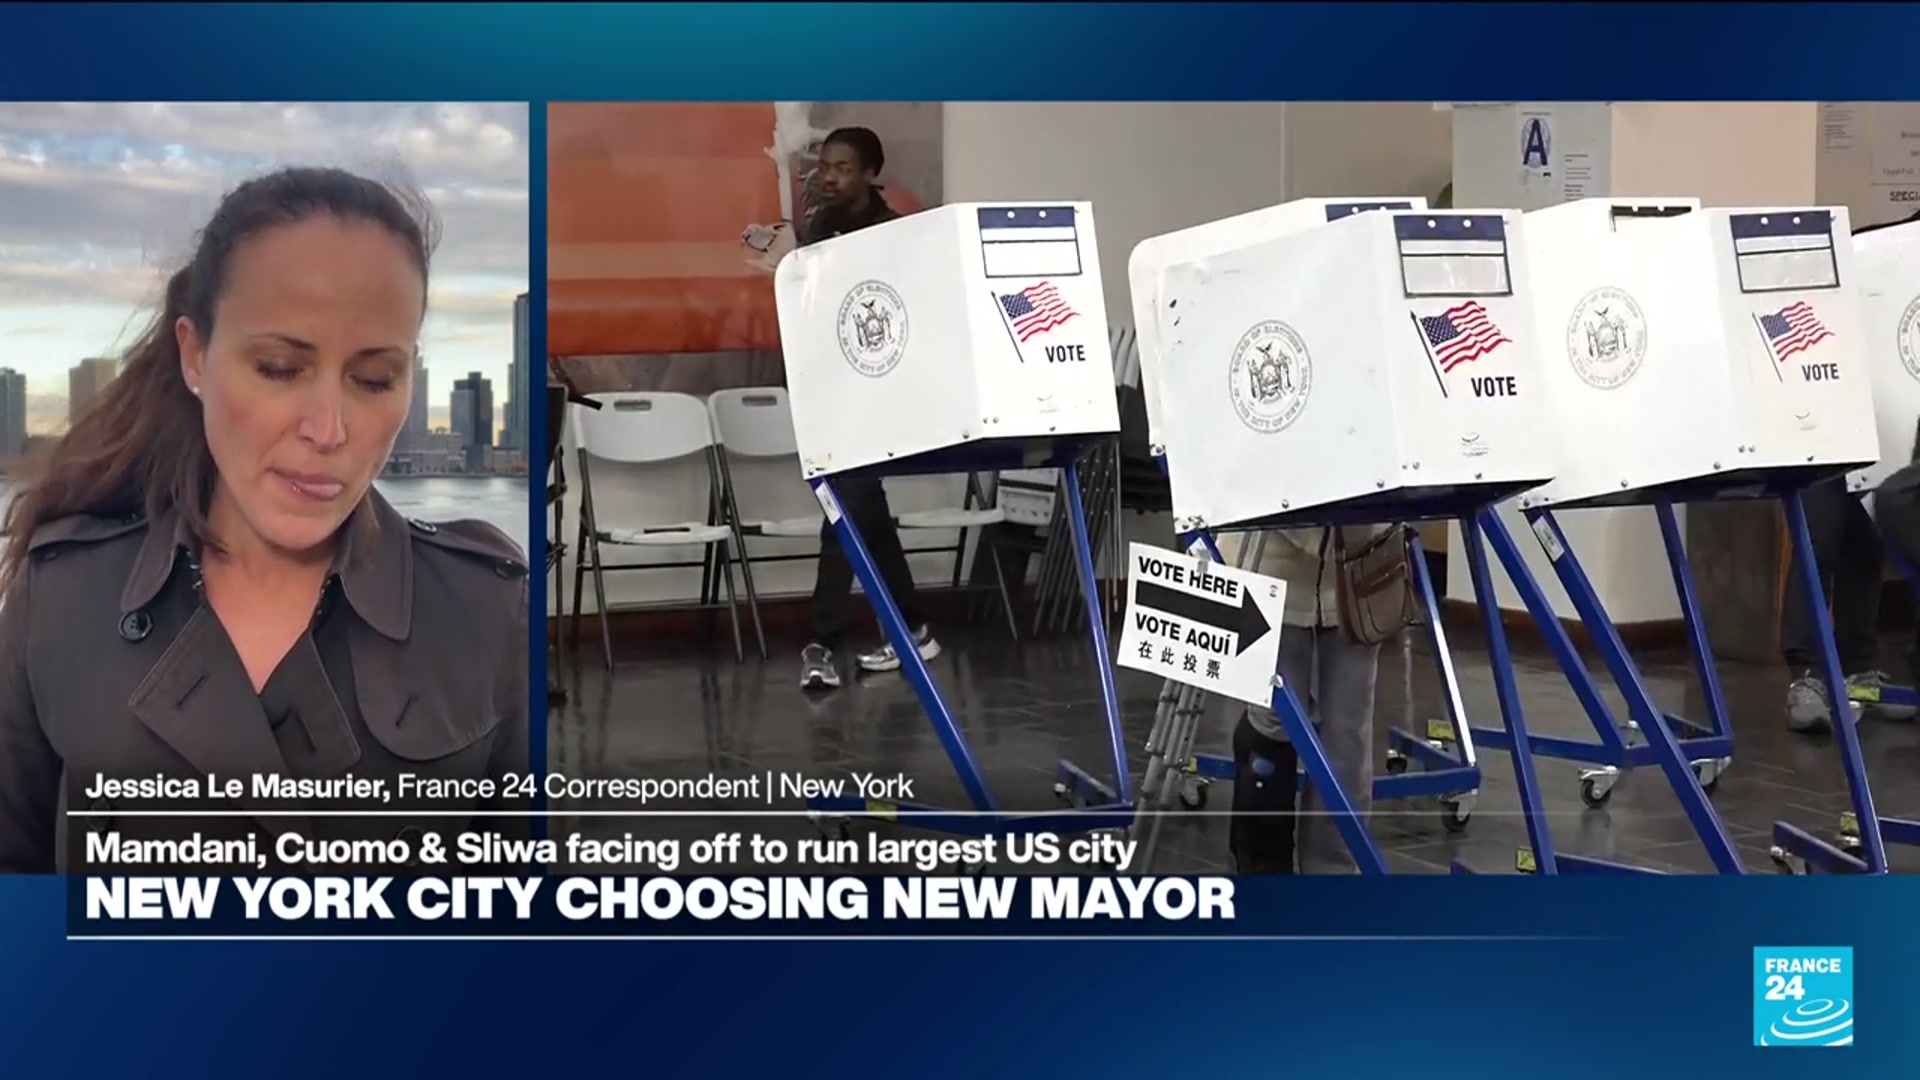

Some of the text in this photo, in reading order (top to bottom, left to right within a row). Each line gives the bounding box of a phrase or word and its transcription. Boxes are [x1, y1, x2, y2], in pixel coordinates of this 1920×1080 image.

[1522, 118, 1548, 166] A
[1045, 345, 1086, 363] VOTE
[1801, 363, 1839, 382] VOTE
[1471, 376, 1517, 397] VOTE
[1138, 556, 1184, 583] VOTE
[1189, 569, 1239, 598] HERE
[1135, 612, 1231, 655] VOTE AQUÍ
[1138, 640, 1221, 680] 在此投票
